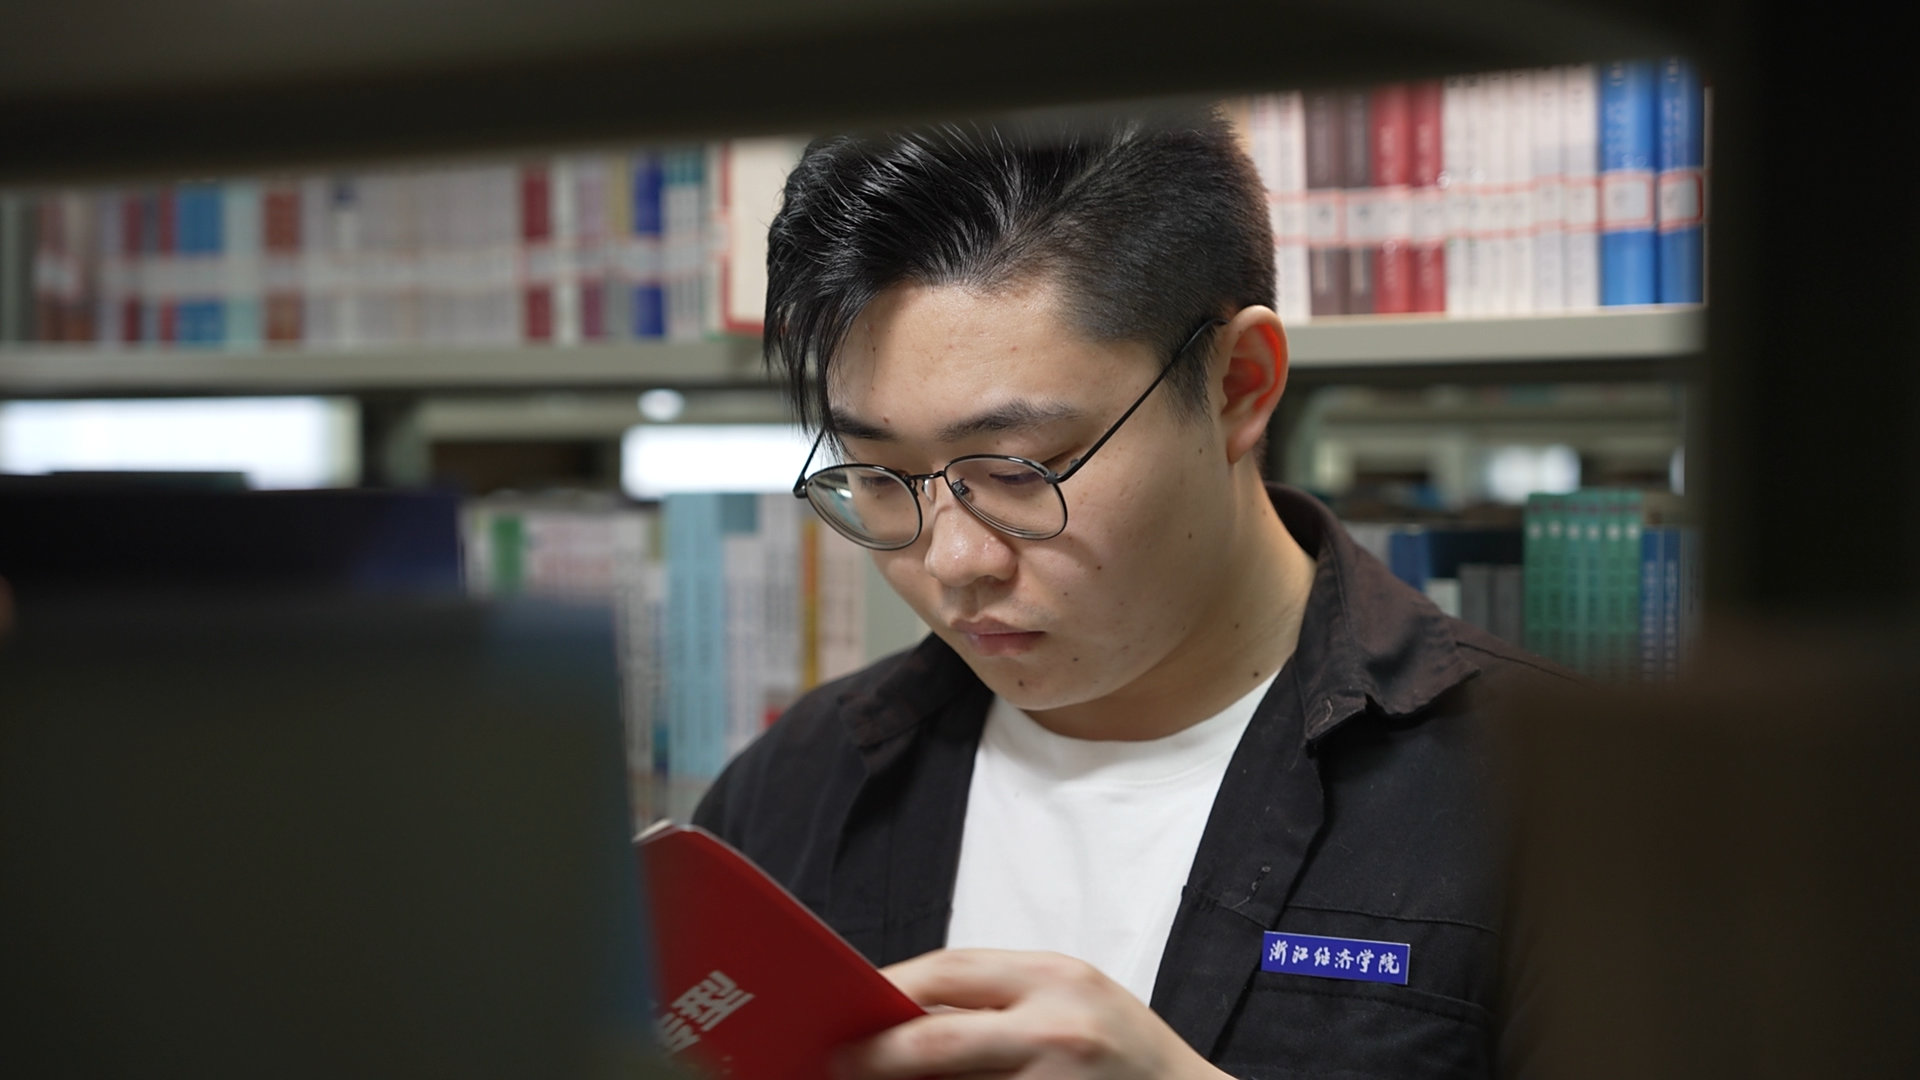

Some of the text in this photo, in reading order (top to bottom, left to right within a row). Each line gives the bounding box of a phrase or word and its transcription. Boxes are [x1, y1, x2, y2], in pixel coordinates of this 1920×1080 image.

[1268, 938, 1400, 975] 浙江经济学院
